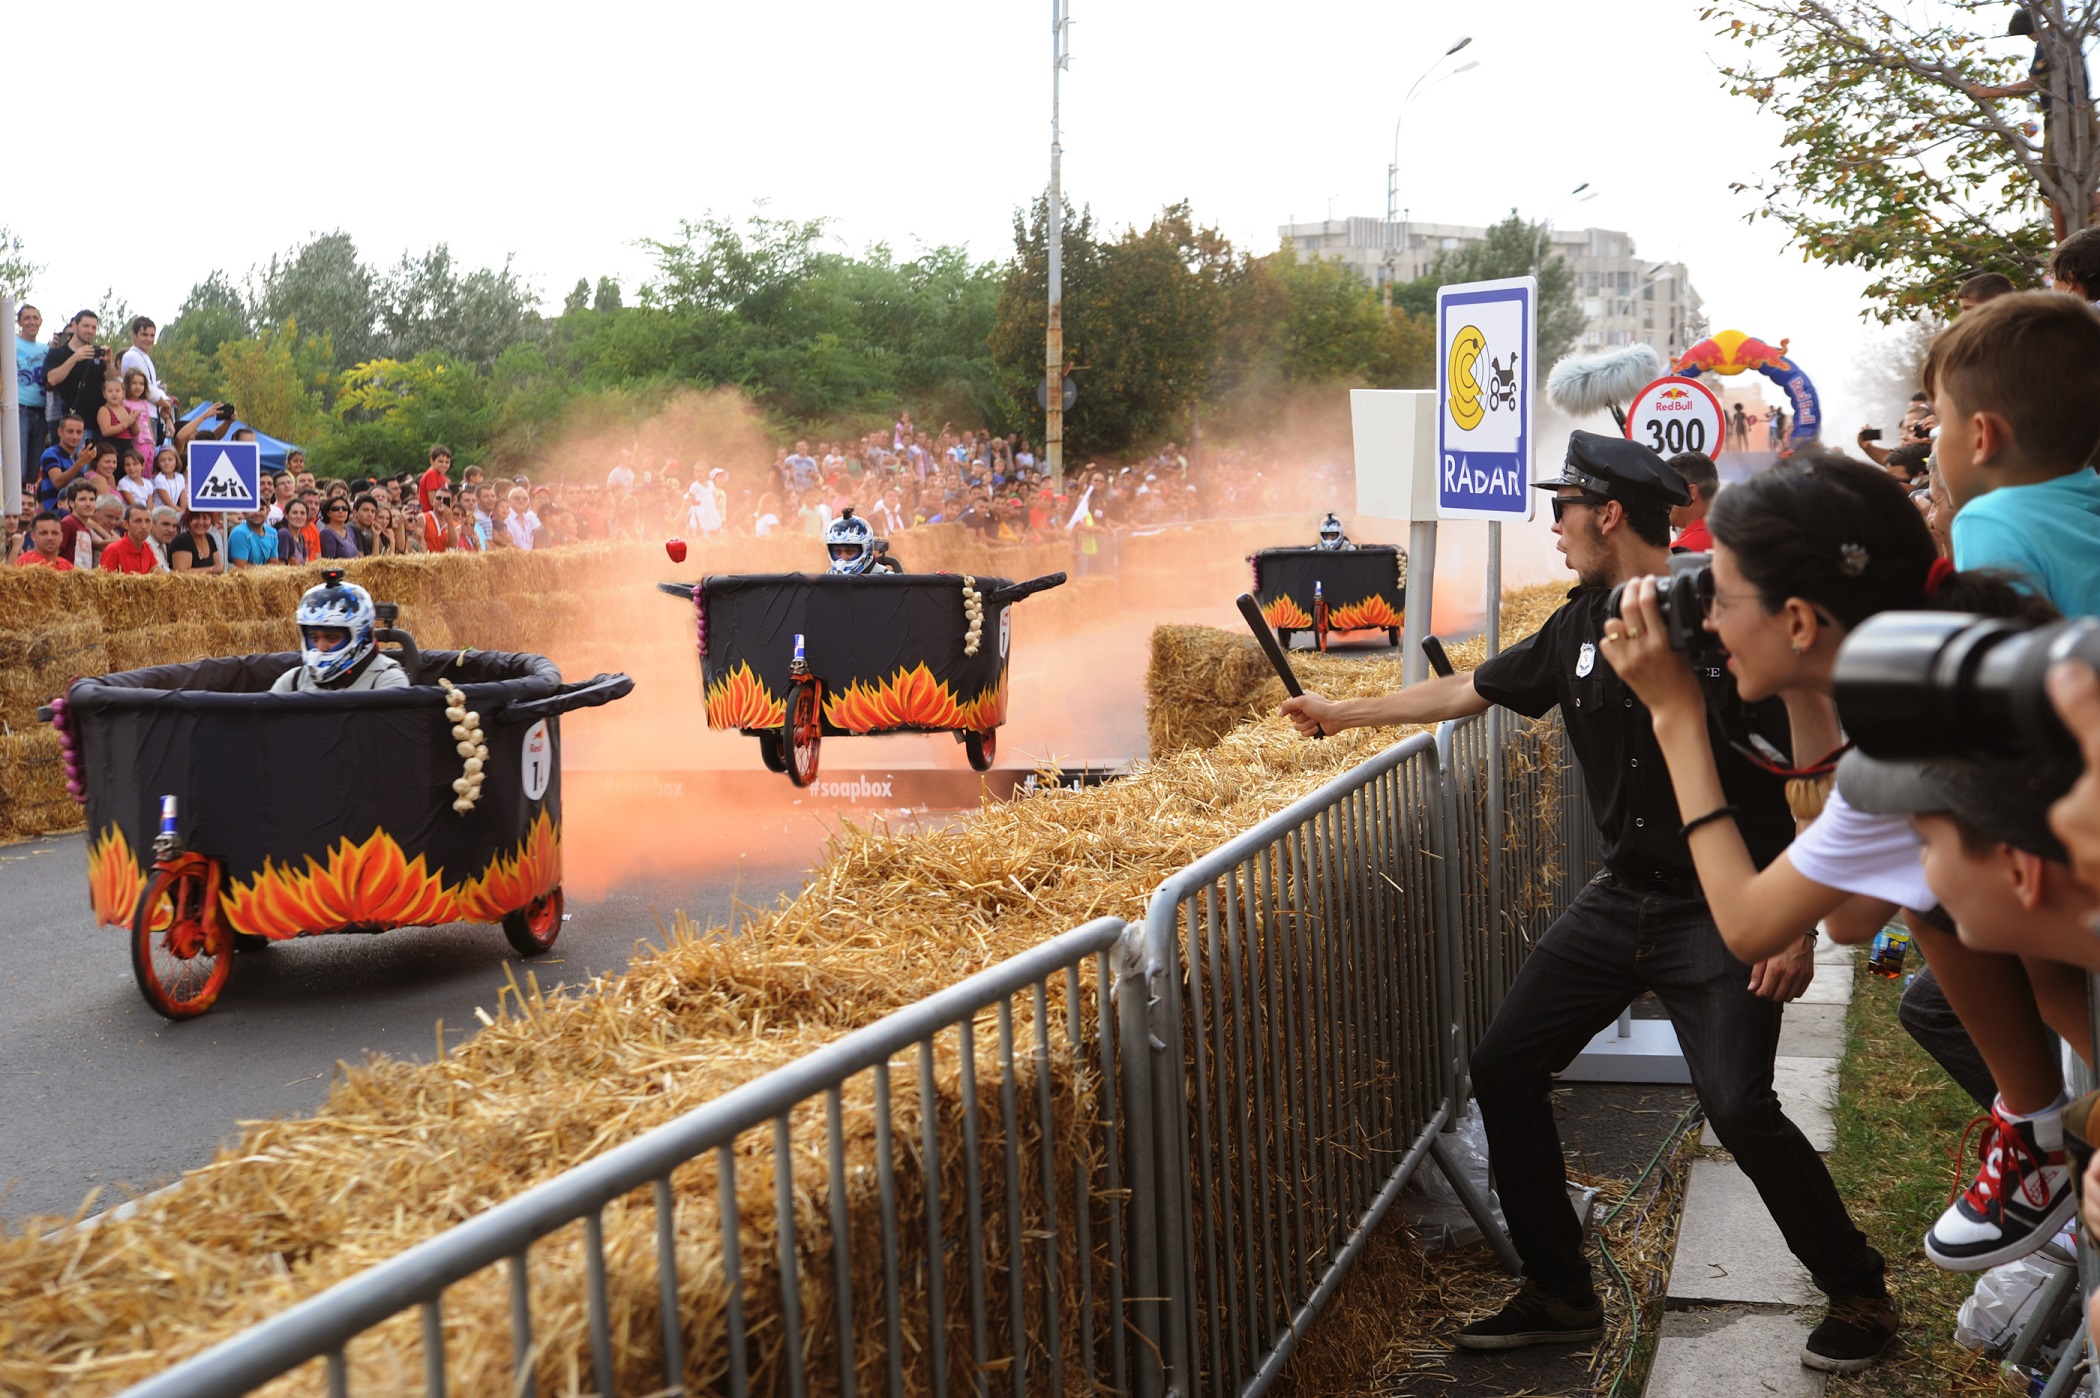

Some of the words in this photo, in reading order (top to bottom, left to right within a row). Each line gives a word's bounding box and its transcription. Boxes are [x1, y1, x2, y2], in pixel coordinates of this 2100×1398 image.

[1789, 376, 1812, 402] Red
[1655, 401, 1674, 411] Red
[1675, 401, 1693, 411] Bull
[1798, 400, 1816, 425] Bull
[1647, 418, 1704, 454] 300
[808, 774, 893, 803] #soapbox
